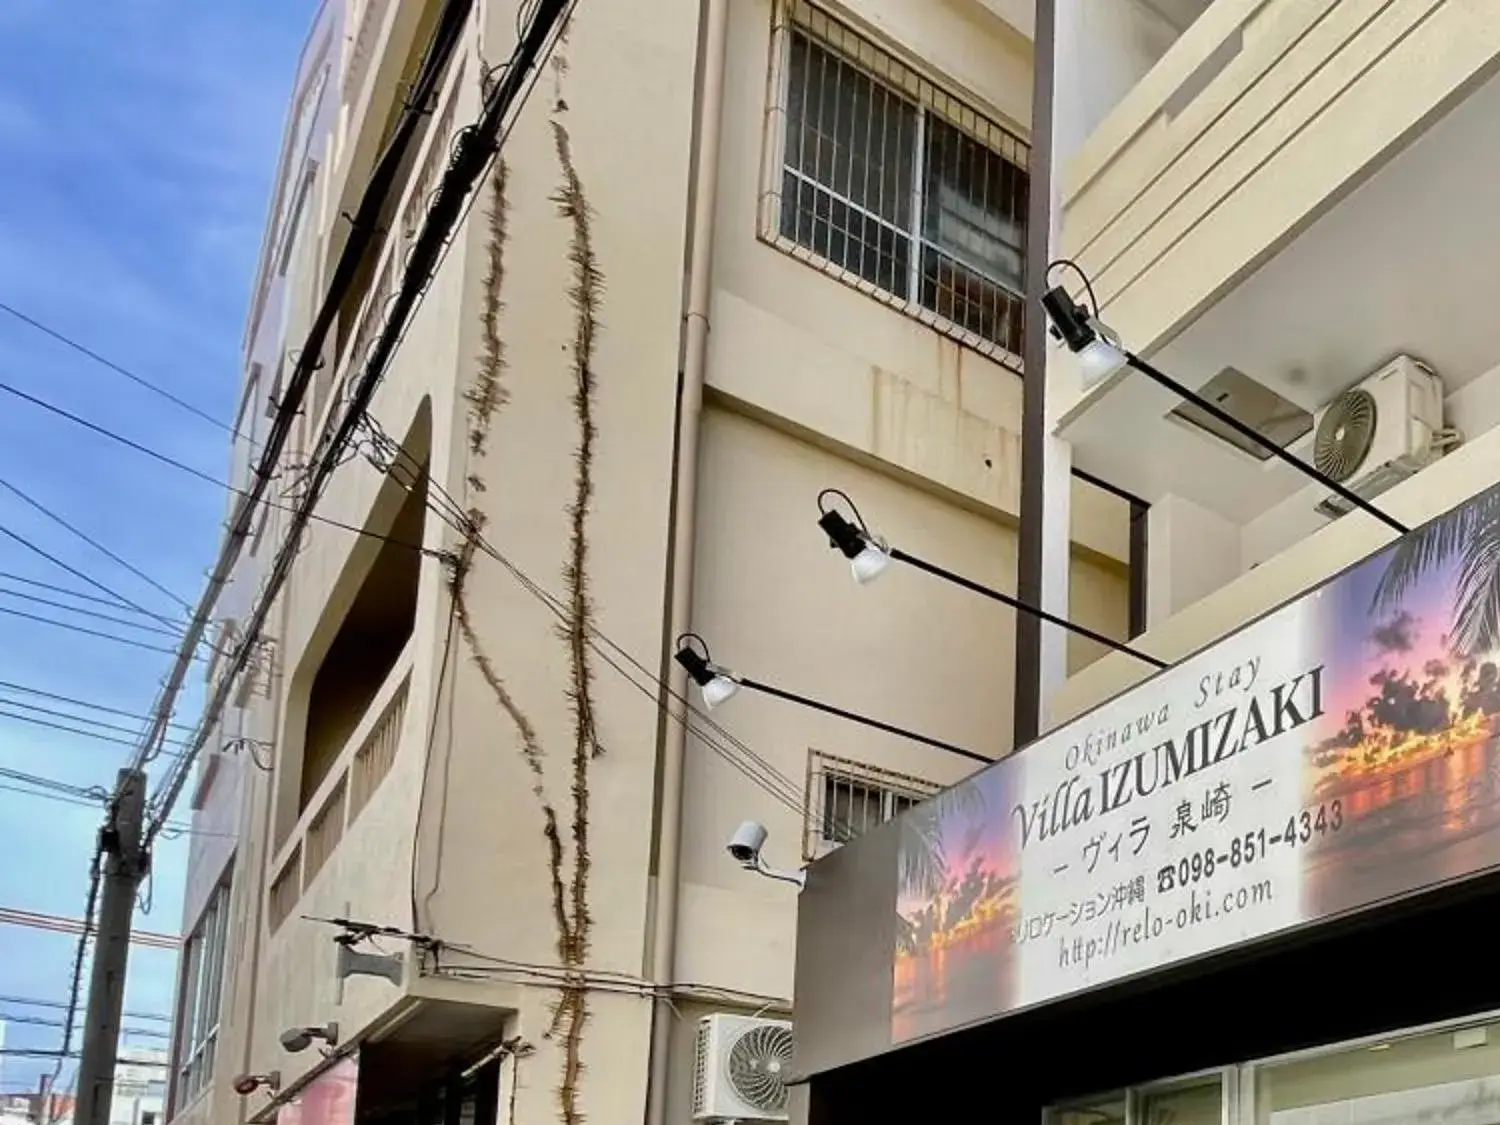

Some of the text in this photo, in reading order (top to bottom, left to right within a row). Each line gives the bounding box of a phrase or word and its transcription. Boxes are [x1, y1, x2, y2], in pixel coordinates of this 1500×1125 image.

[1013, 665, 1325, 849] Villa IZUMIZAKI
[1065, 656, 1261, 771] Okinawa Stay
[1082, 816, 1151, 874] ヴィラ
[1169, 782, 1233, 840] 泉崎
[1059, 879, 1273, 969] http://relo-oki.com
